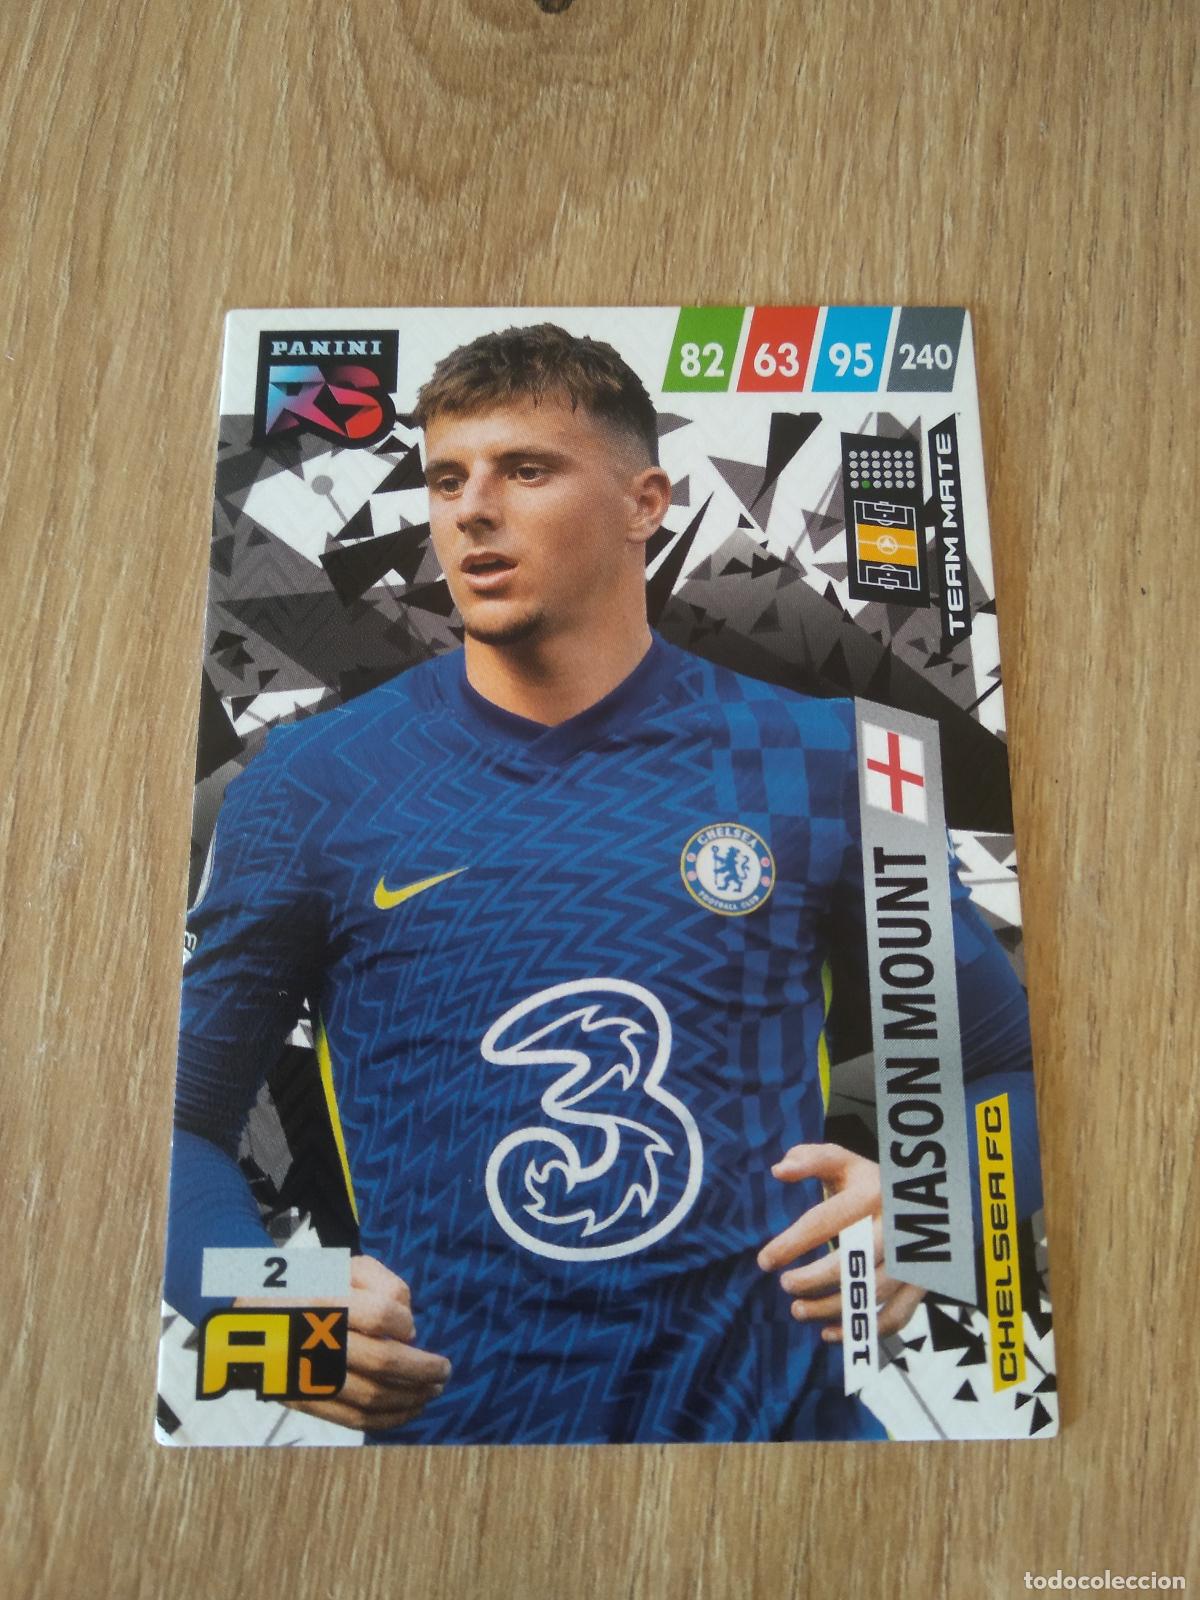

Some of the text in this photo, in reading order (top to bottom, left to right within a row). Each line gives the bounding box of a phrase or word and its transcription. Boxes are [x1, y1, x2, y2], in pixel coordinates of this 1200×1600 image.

[270, 340, 382, 356] PANINI
[680, 342, 725, 377] 82
[753, 342, 800, 377] 63
[828, 342, 874, 377] 95
[899, 343, 953, 370] 240
[935, 432, 965, 637] TEAM MATE
[697, 827, 757, 849] CHELSEA
[873, 846, 953, 1263] MASON MOUNT
[983, 1105, 1018, 1383] CHELSEA FC
[262, 1256, 288, 1288] 2
[849, 1249, 871, 1366] 1999
